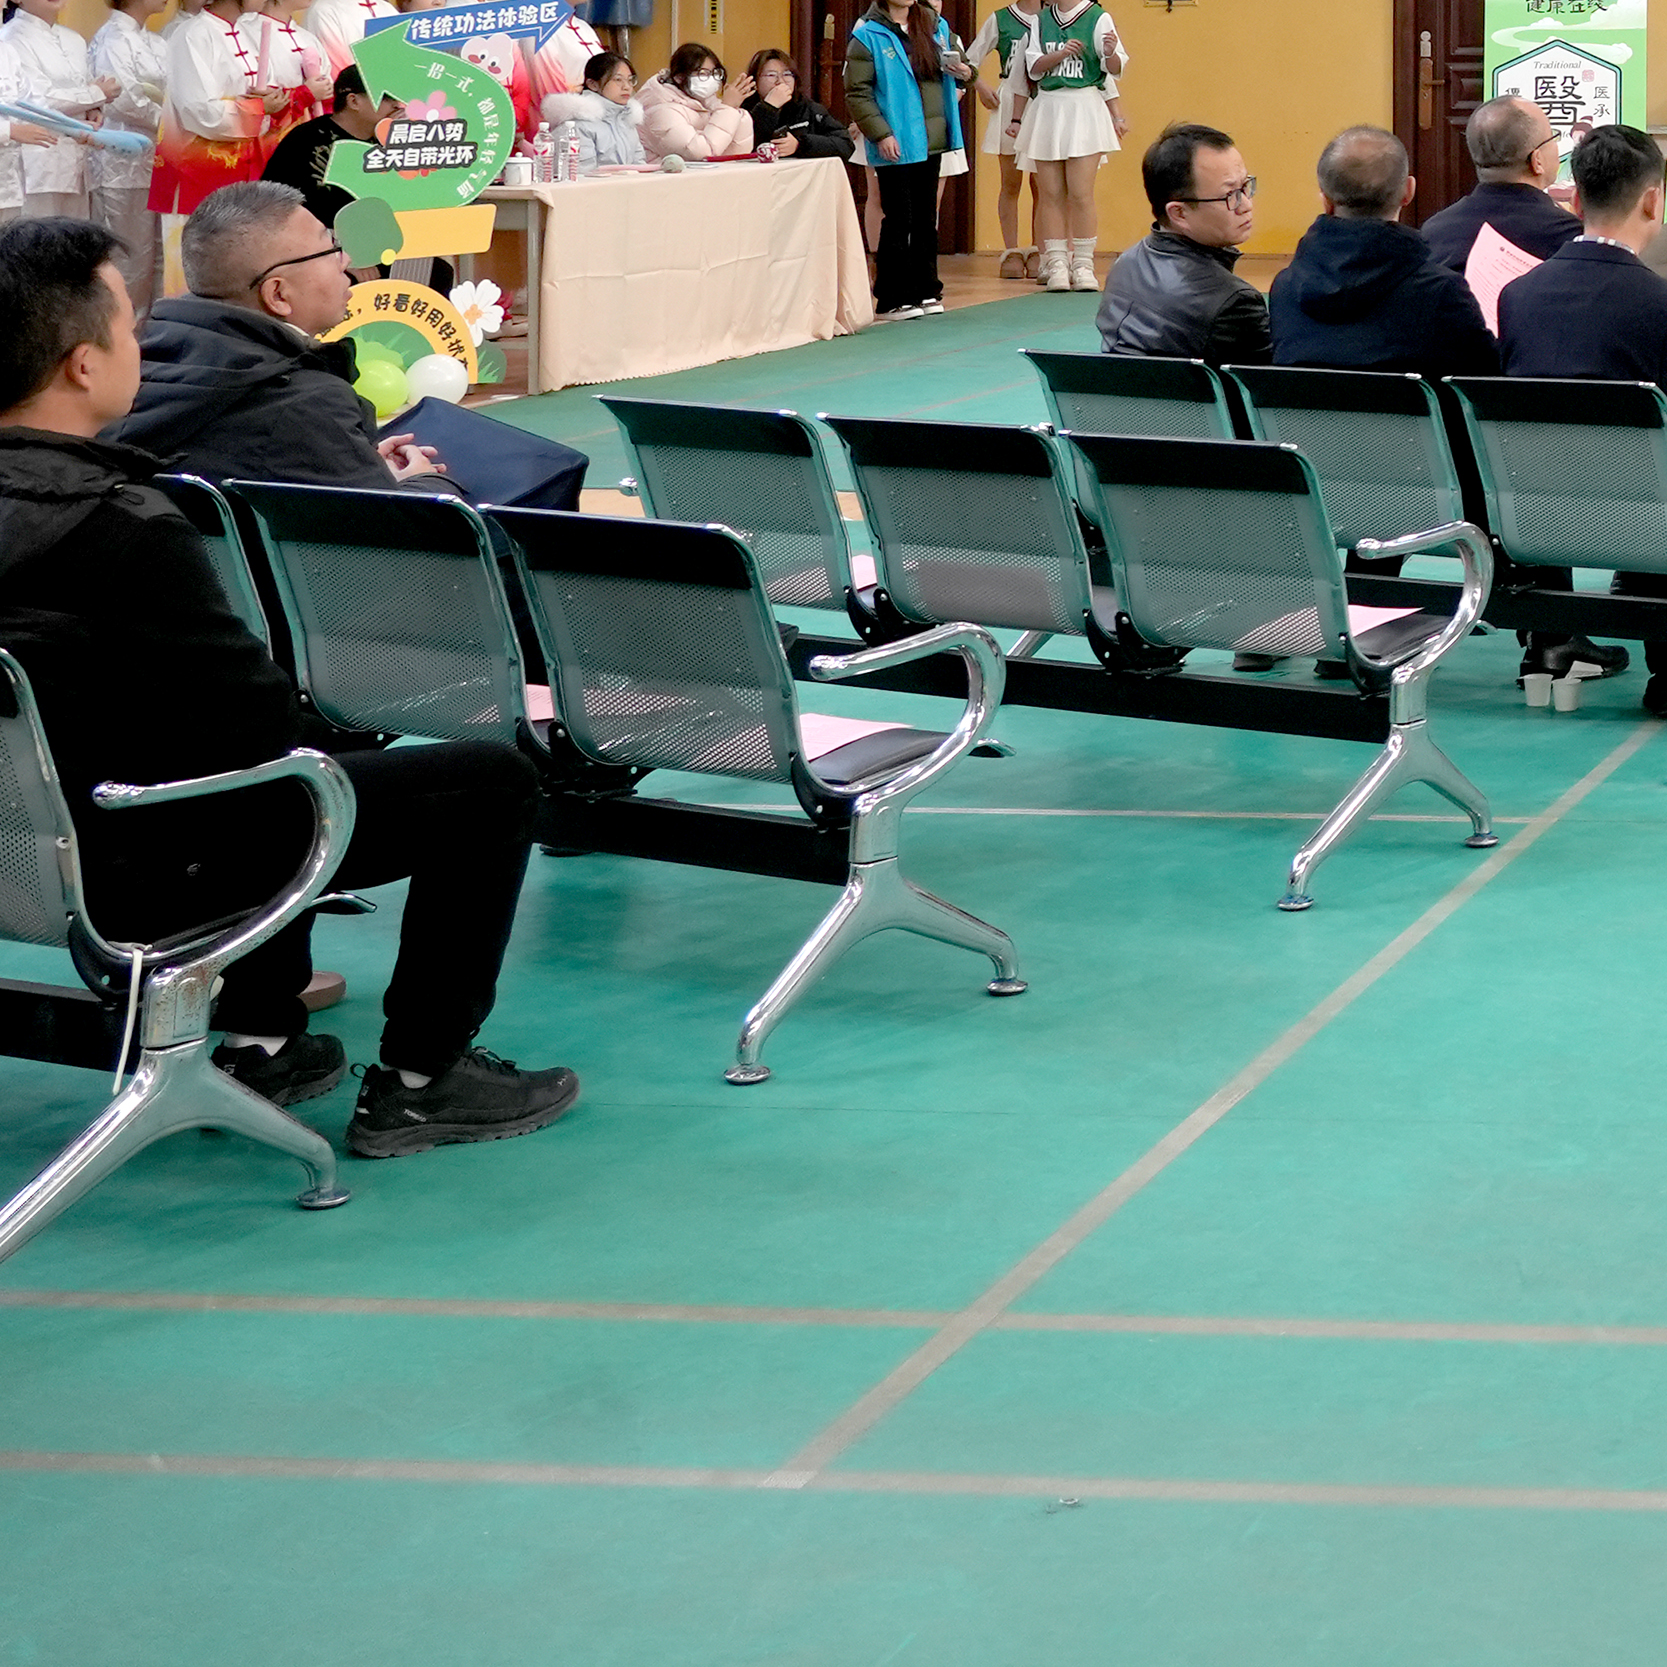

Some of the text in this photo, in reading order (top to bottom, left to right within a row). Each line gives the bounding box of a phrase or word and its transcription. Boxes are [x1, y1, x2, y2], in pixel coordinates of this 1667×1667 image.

[411, 1, 559, 40] 传统功法体验区
[1533, 61, 1582, 69] Traditional
[1593, 86, 1611, 117] 医承
[389, 122, 464, 144] 晨启八势
[366, 146, 475, 169] 全天自带光环
